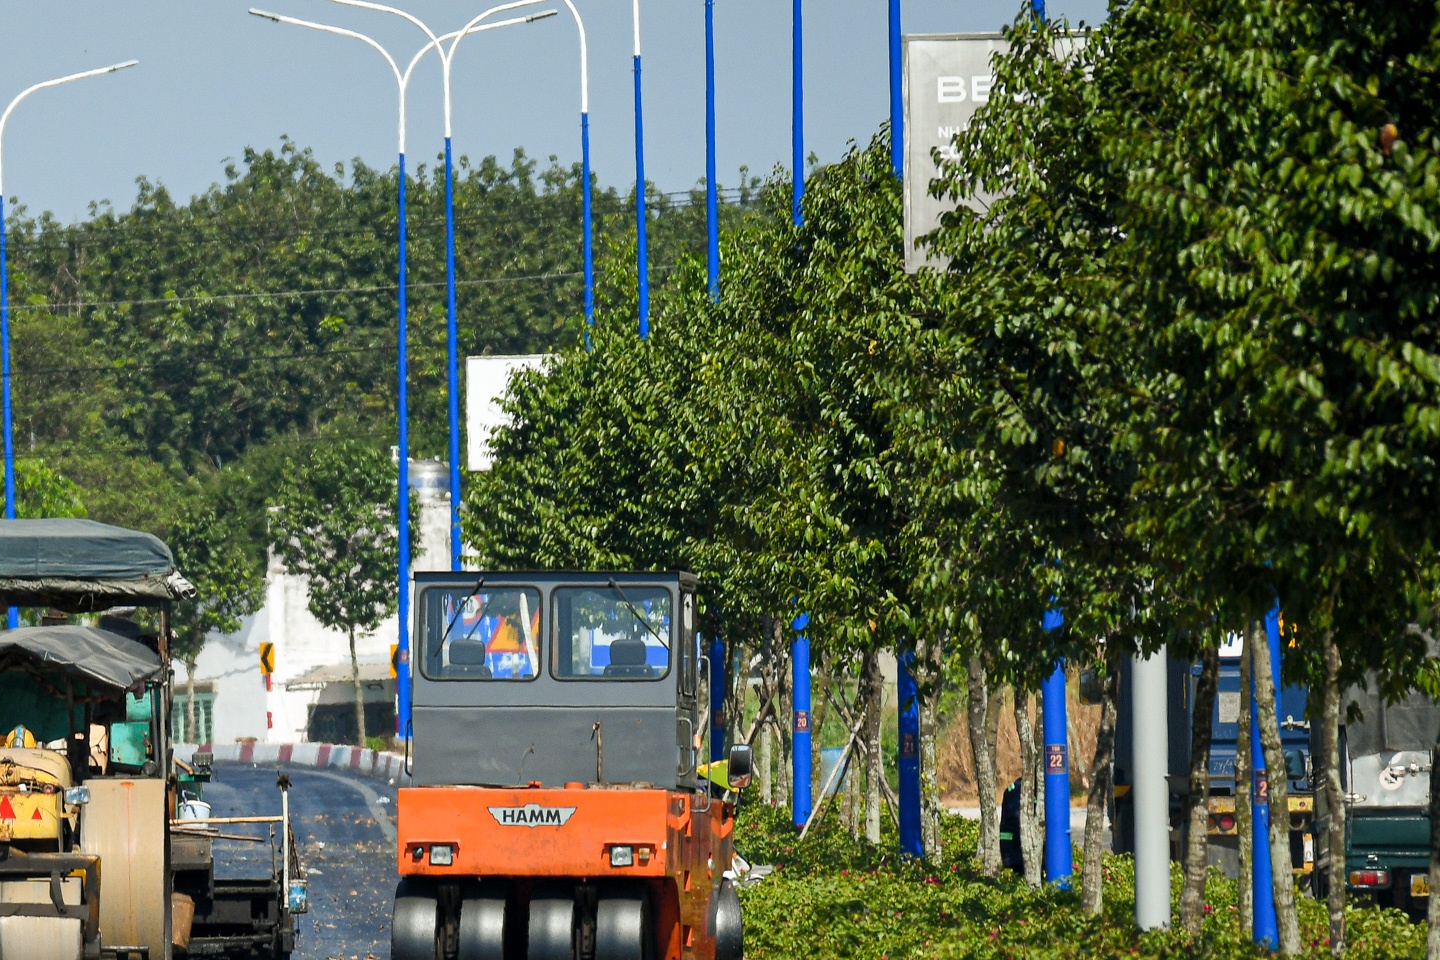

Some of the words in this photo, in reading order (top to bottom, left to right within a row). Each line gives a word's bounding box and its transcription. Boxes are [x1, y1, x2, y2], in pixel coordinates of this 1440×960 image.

[797, 717, 807, 728] 20
[1050, 754, 1063, 768] 22
[1259, 781, 1268, 797] 2
[502, 809, 562, 823] HAMM
